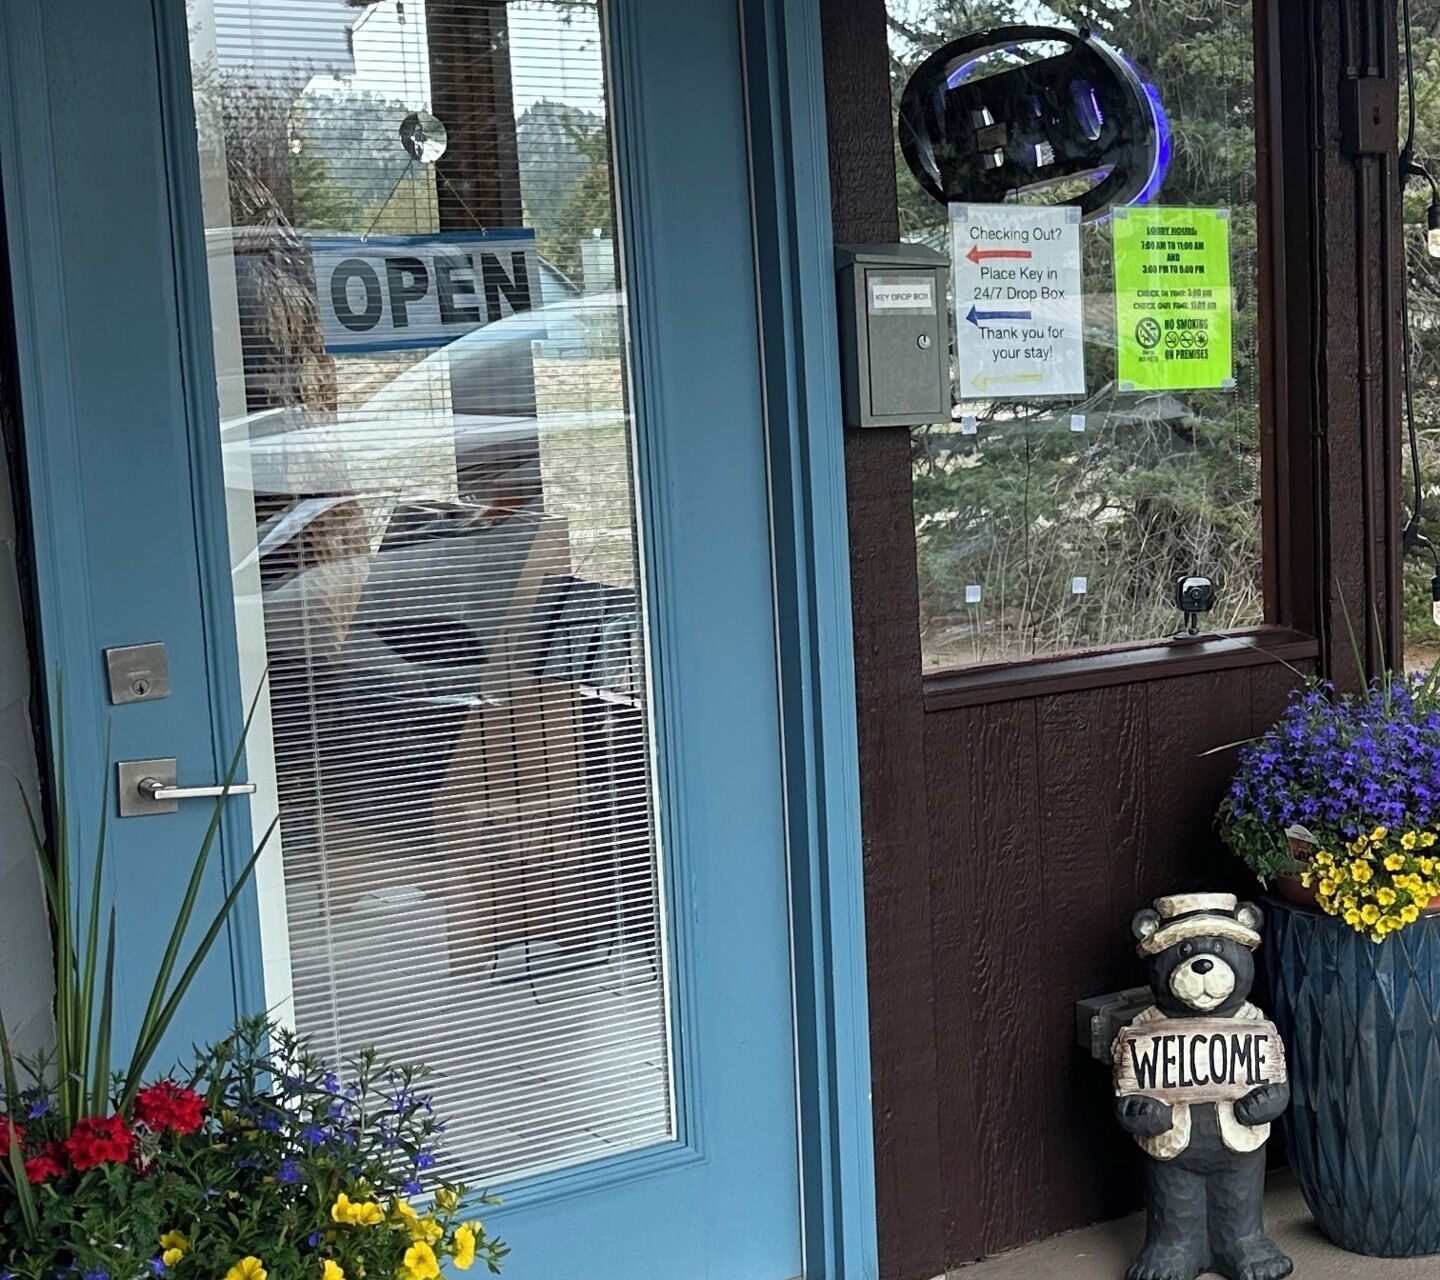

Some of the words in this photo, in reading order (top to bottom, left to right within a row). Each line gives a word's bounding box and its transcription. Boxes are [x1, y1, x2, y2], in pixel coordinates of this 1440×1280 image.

[970, 226, 1029, 243] Checking
[1032, 227, 1062, 241] Out?
[1147, 227, 1170, 236] LOBBY
[1141, 241, 1155, 250] 7:00
[1156, 241, 1166, 250] AM
[1168, 241, 1175, 250] TO
[1177, 241, 1193, 250] 11:00
[1194, 241, 1204, 250] AM
[1167, 253, 1180, 262] AND
[980, 267, 1016, 280] Place
[1020, 267, 1043, 283] Key
[1047, 267, 1058, 280] in
[1142, 265, 1157, 274] 3:00
[1159, 265, 1169, 274] PM
[1169, 265, 1178, 274] TO
[1195, 265, 1205, 274] PM
[330, 251, 532, 332] OPEN
[875, 293, 890, 301] KEY
[891, 293, 912, 301] DROP
[974, 286, 1002, 300] 24/7
[1007, 287, 1037, 302] Drop
[1041, 286, 1065, 300] Box
[1133, 302, 1156, 310] CHECK
[1157, 302, 1171, 310] OUT
[1164, 319, 1174, 330] NO
[1176, 319, 1208, 330] SMOKING
[978, 326, 1018, 339] Thank
[1021, 329, 1044, 342] you
[1048, 326, 1064, 338] for
[992, 349, 1020, 363] your
[1024, 345, 1053, 361] stay!
[1165, 349, 1174, 360] ON
[1176, 349, 1209, 360] PREMISES
[1127, 1033, 1270, 1089] WELCOME
